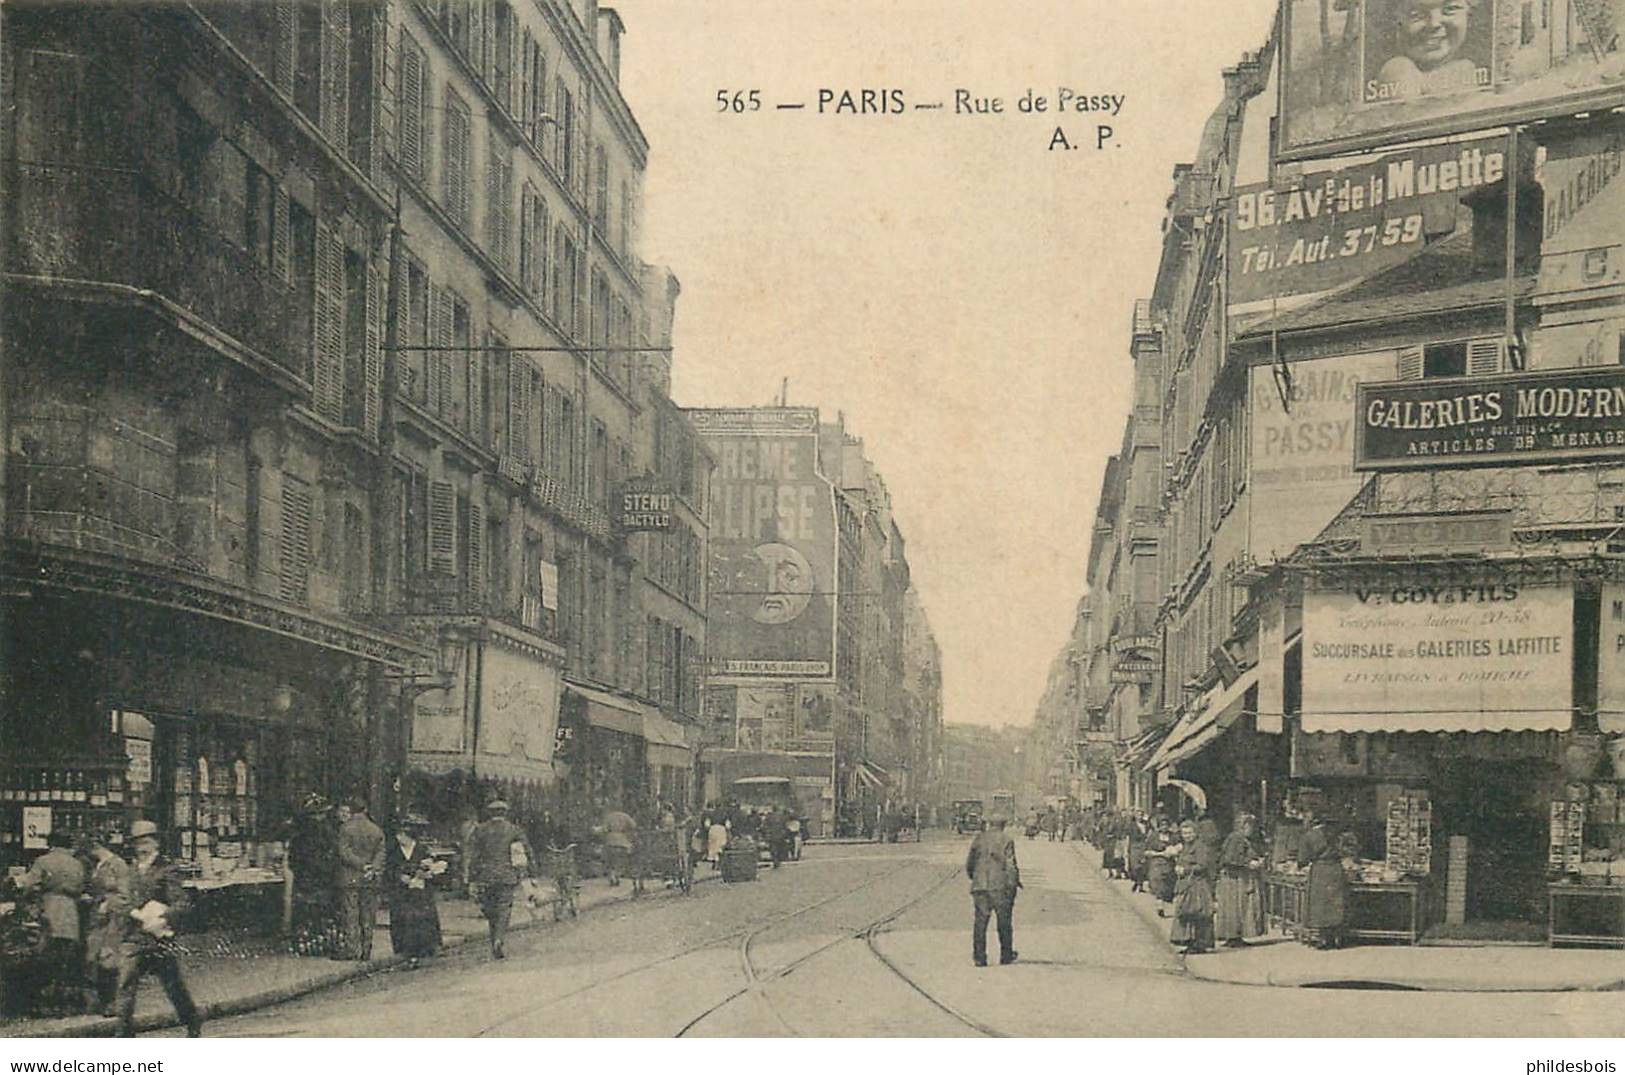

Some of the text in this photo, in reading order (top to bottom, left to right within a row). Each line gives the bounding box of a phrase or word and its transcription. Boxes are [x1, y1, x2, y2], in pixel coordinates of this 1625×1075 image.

[1338, 179, 1364, 212] de
[1388, 149, 1504, 200] Muette
[1367, 391, 1503, 429] GALERIES
[1264, 419, 1351, 455] PASSY
[1406, 437, 1496, 456] ARTICLES
[624, 494, 670, 511] STENO
[1460, 581, 1519, 603] FILS
[1311, 642, 1394, 659] SUCCURSALE
[1417, 638, 1491, 659] GALERIES
[1499, 635, 1562, 657] LAFFITTE
